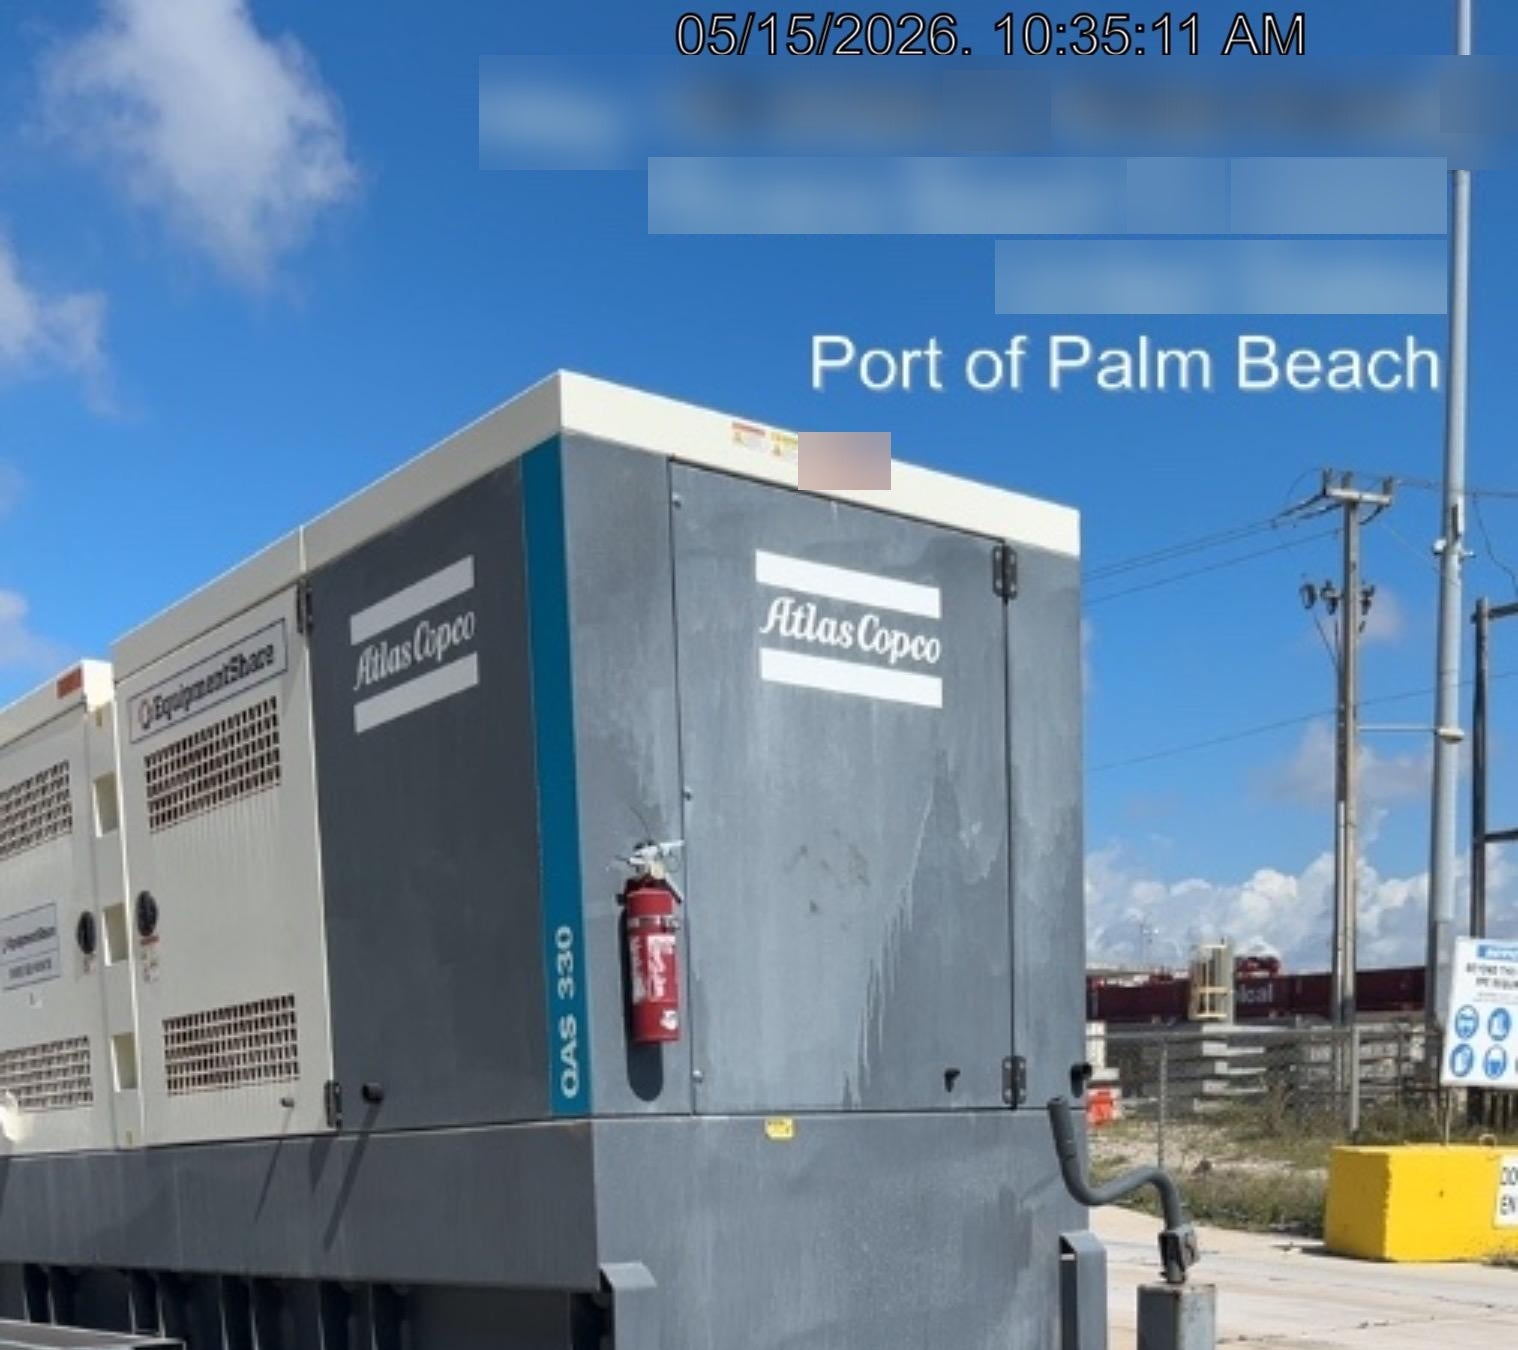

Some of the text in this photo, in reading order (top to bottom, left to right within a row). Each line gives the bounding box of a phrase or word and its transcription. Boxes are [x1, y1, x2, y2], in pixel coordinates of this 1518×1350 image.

[352, 611, 476, 691] Atlas Copco
[760, 596, 942, 664] Atlas Copco
[153, 643, 274, 721] EquipmentShare
[554, 925, 575, 1000] 330
